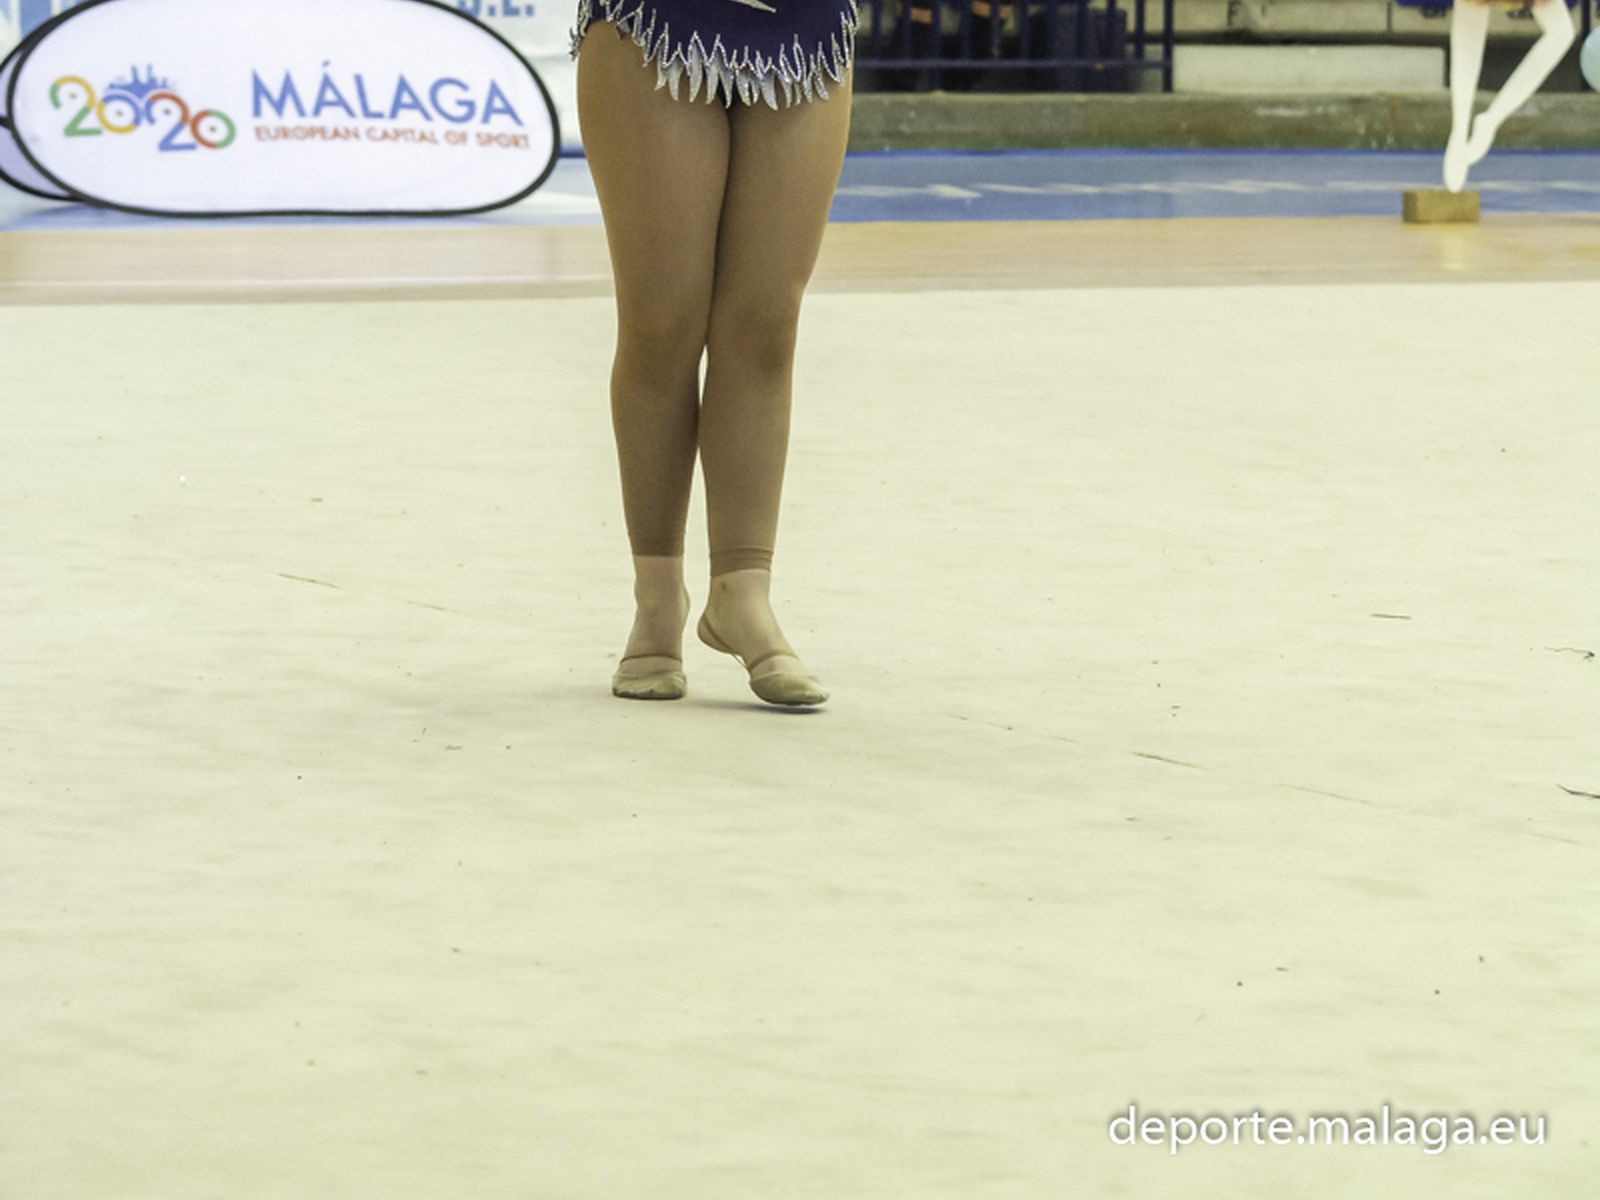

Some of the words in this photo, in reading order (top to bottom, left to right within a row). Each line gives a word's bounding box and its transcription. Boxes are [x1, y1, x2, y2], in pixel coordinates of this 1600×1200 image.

[49, 75, 236, 153] 2020
[251, 59, 525, 127] MÁLAGA
[254, 124, 362, 142] EUROPEAN
[366, 126, 438, 145] CAPITAL
[443, 129, 468, 146] OF
[475, 132, 530, 150] SPORT
